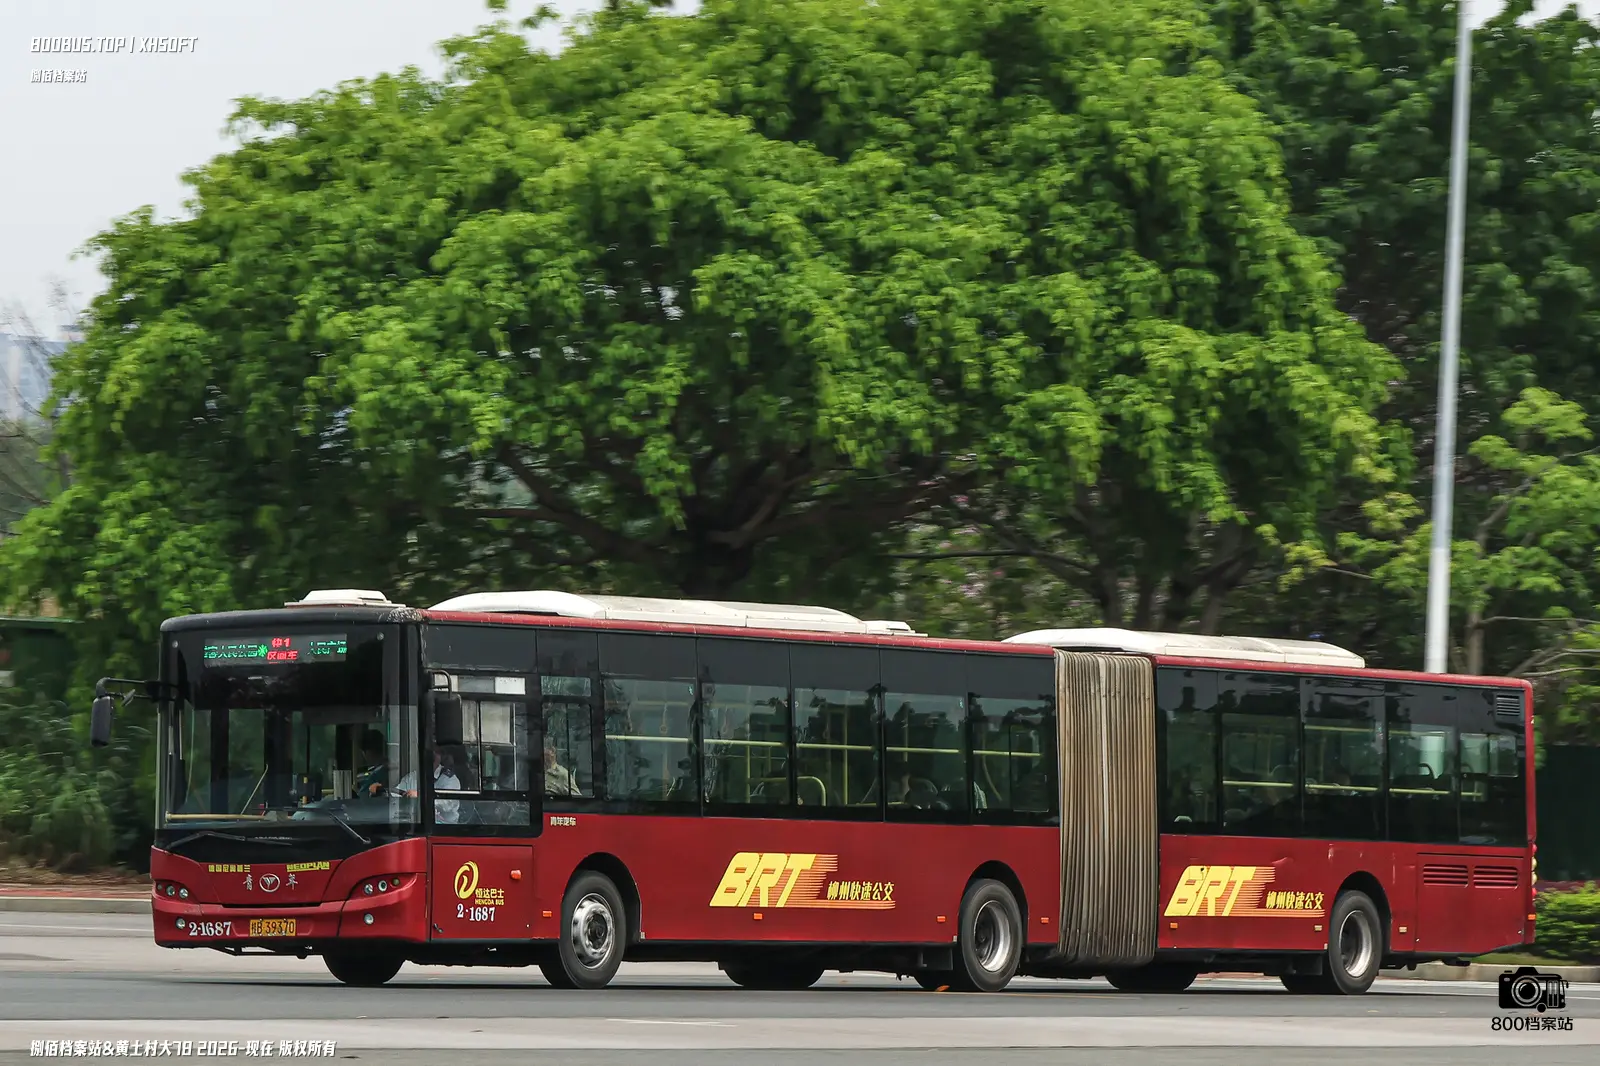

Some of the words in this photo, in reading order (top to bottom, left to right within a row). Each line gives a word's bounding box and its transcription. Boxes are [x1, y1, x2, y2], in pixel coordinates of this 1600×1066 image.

[550, 816, 577, 827] 青年汽车
[286, 861, 330, 873] NEOPLAN
[709, 852, 817, 908] BRT
[475, 888, 505, 899] 恒达巴士
[826, 880, 895, 901] 柳州快速公交
[1163, 865, 1257, 917] BRT
[1265, 891, 1325, 910] 柳州快速公交
[188, 921, 232, 937] 2-1687
